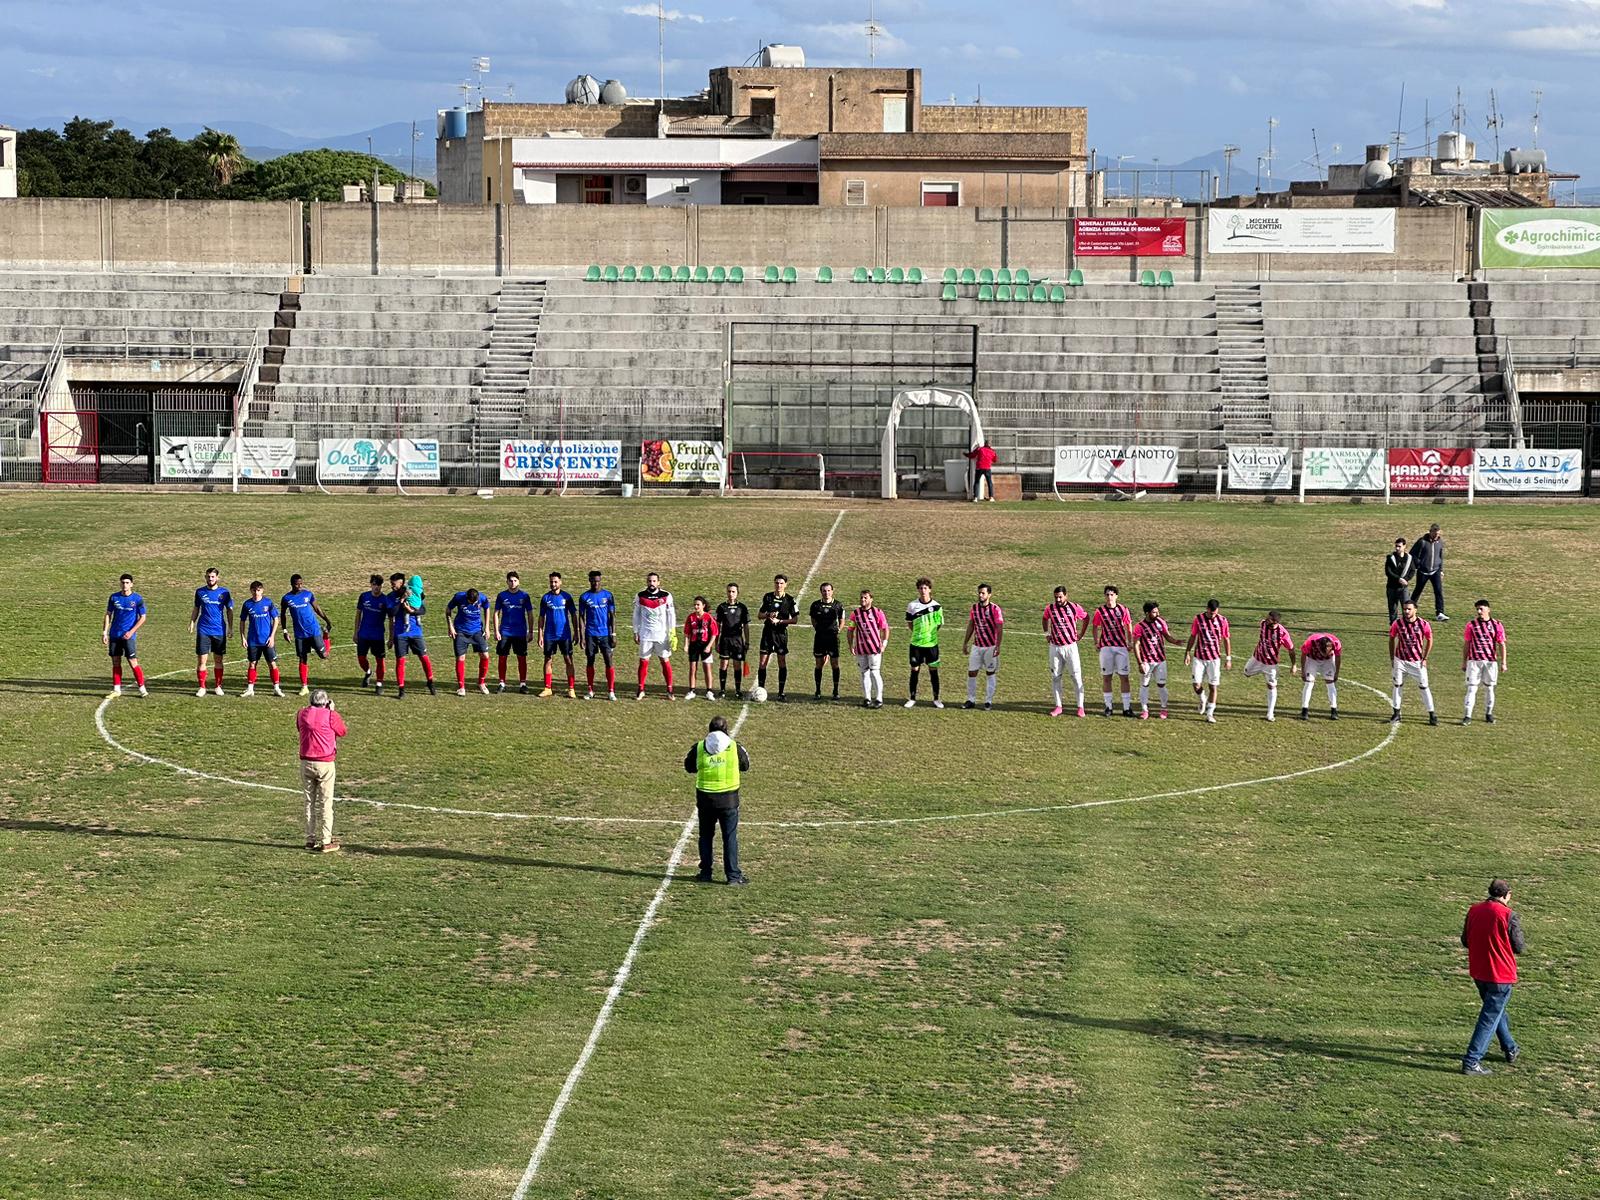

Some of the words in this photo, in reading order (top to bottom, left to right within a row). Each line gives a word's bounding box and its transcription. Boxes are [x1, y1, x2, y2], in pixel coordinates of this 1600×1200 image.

[1520, 229, 1600, 245] Agrochimica
[504, 443, 619, 454] Autodemolizione
[677, 442, 715, 455] Frutta
[327, 449, 361, 466] Oasi
[366, 449, 398, 466] Bar
[504, 455, 618, 469] CRESCENTE
[669, 458, 719, 471] Verdura
[1524, 476, 1531, 484] di
[1533, 476, 1569, 484] Selinunte
